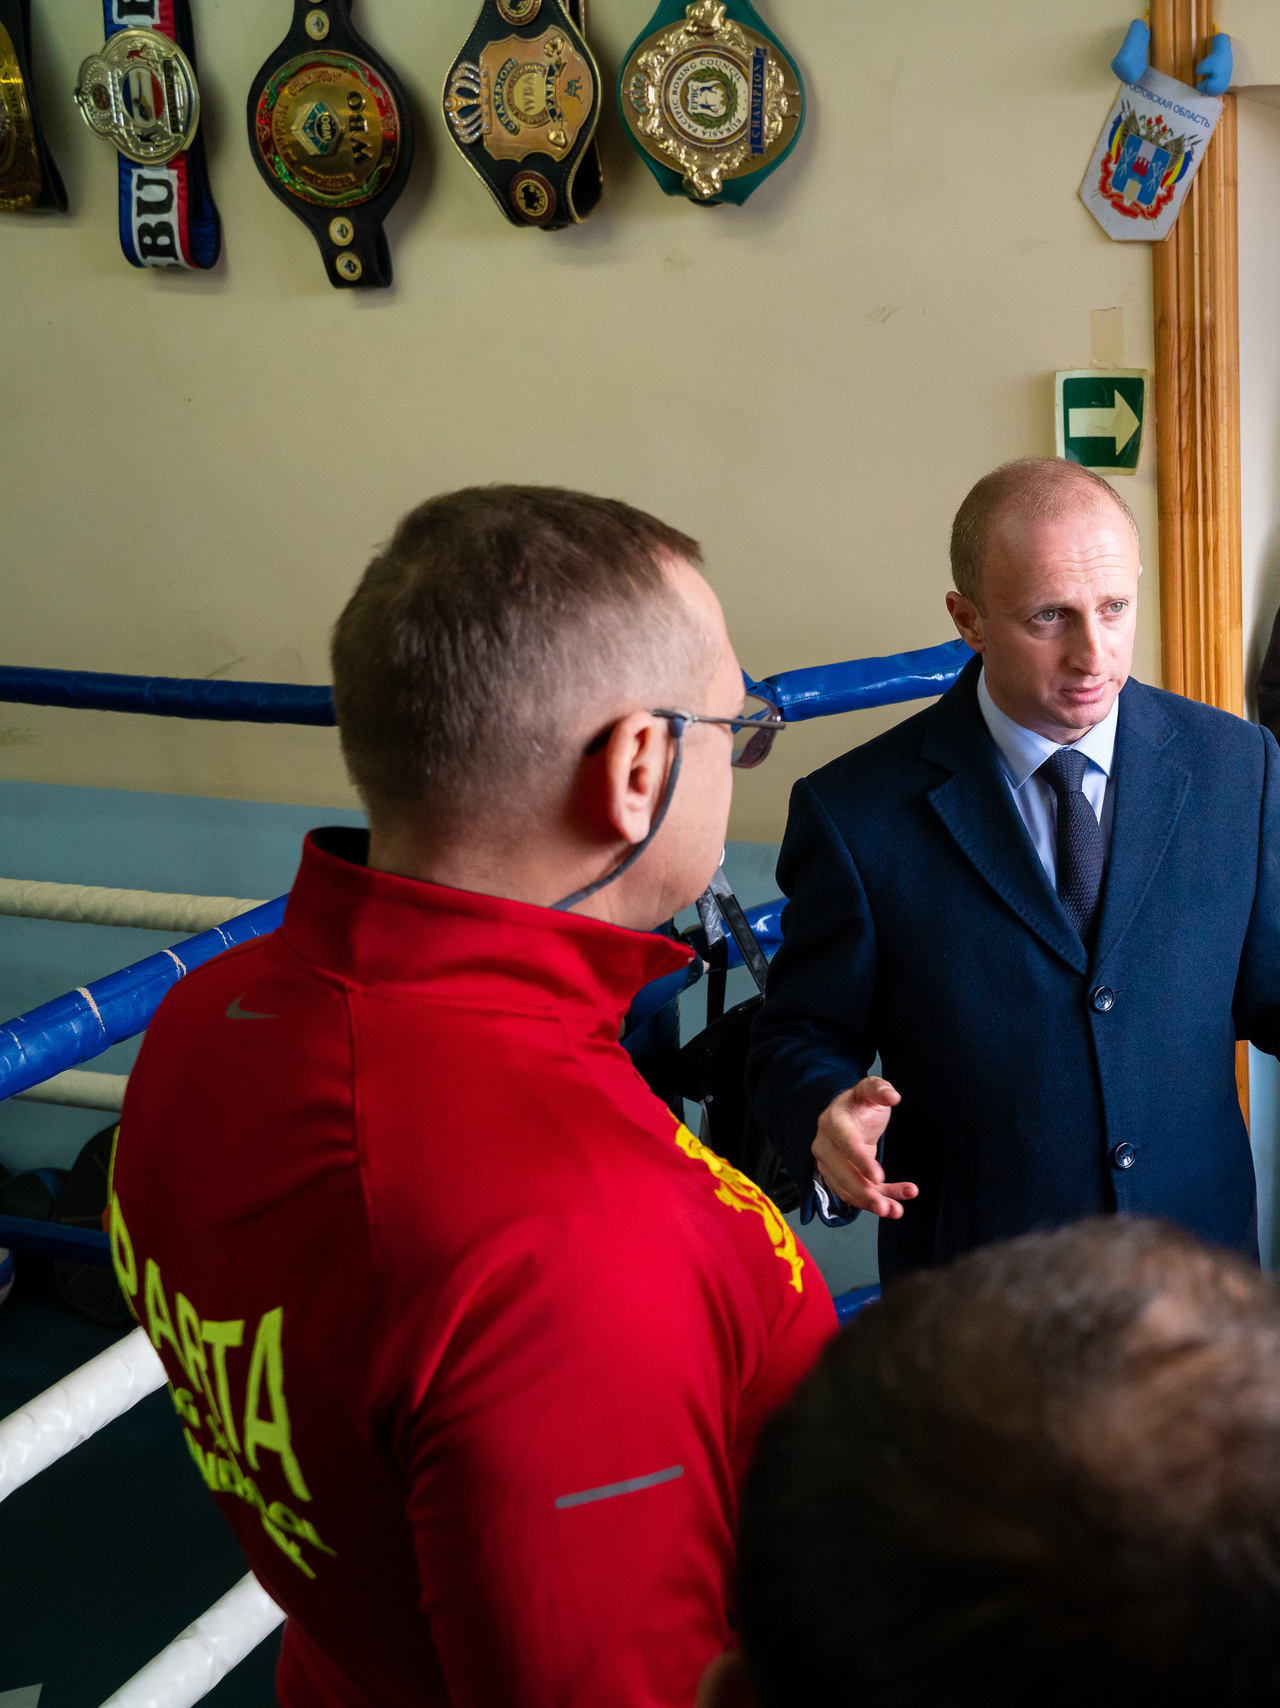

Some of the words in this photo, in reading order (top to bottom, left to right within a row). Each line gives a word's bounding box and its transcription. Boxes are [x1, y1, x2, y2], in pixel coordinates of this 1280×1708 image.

[672, 62, 697, 96] BOXING
[700, 58, 742, 83] COUNCIL
[495, 59, 517, 133] CHAMPION
[545, 75, 556, 109] PABA
[690, 84, 699, 111] EPBC
[751, 63, 762, 139] CHAMPION
[1126, 82, 1173, 110] ОСТОВСКАЯ
[1173, 104, 1211, 129] ОБЛАСТЬ
[320, 114, 331, 141] WBO
[347, 91, 373, 165] WBO
[672, 99, 698, 133] PACIFIC
[701, 118, 743, 138] EURASIA
